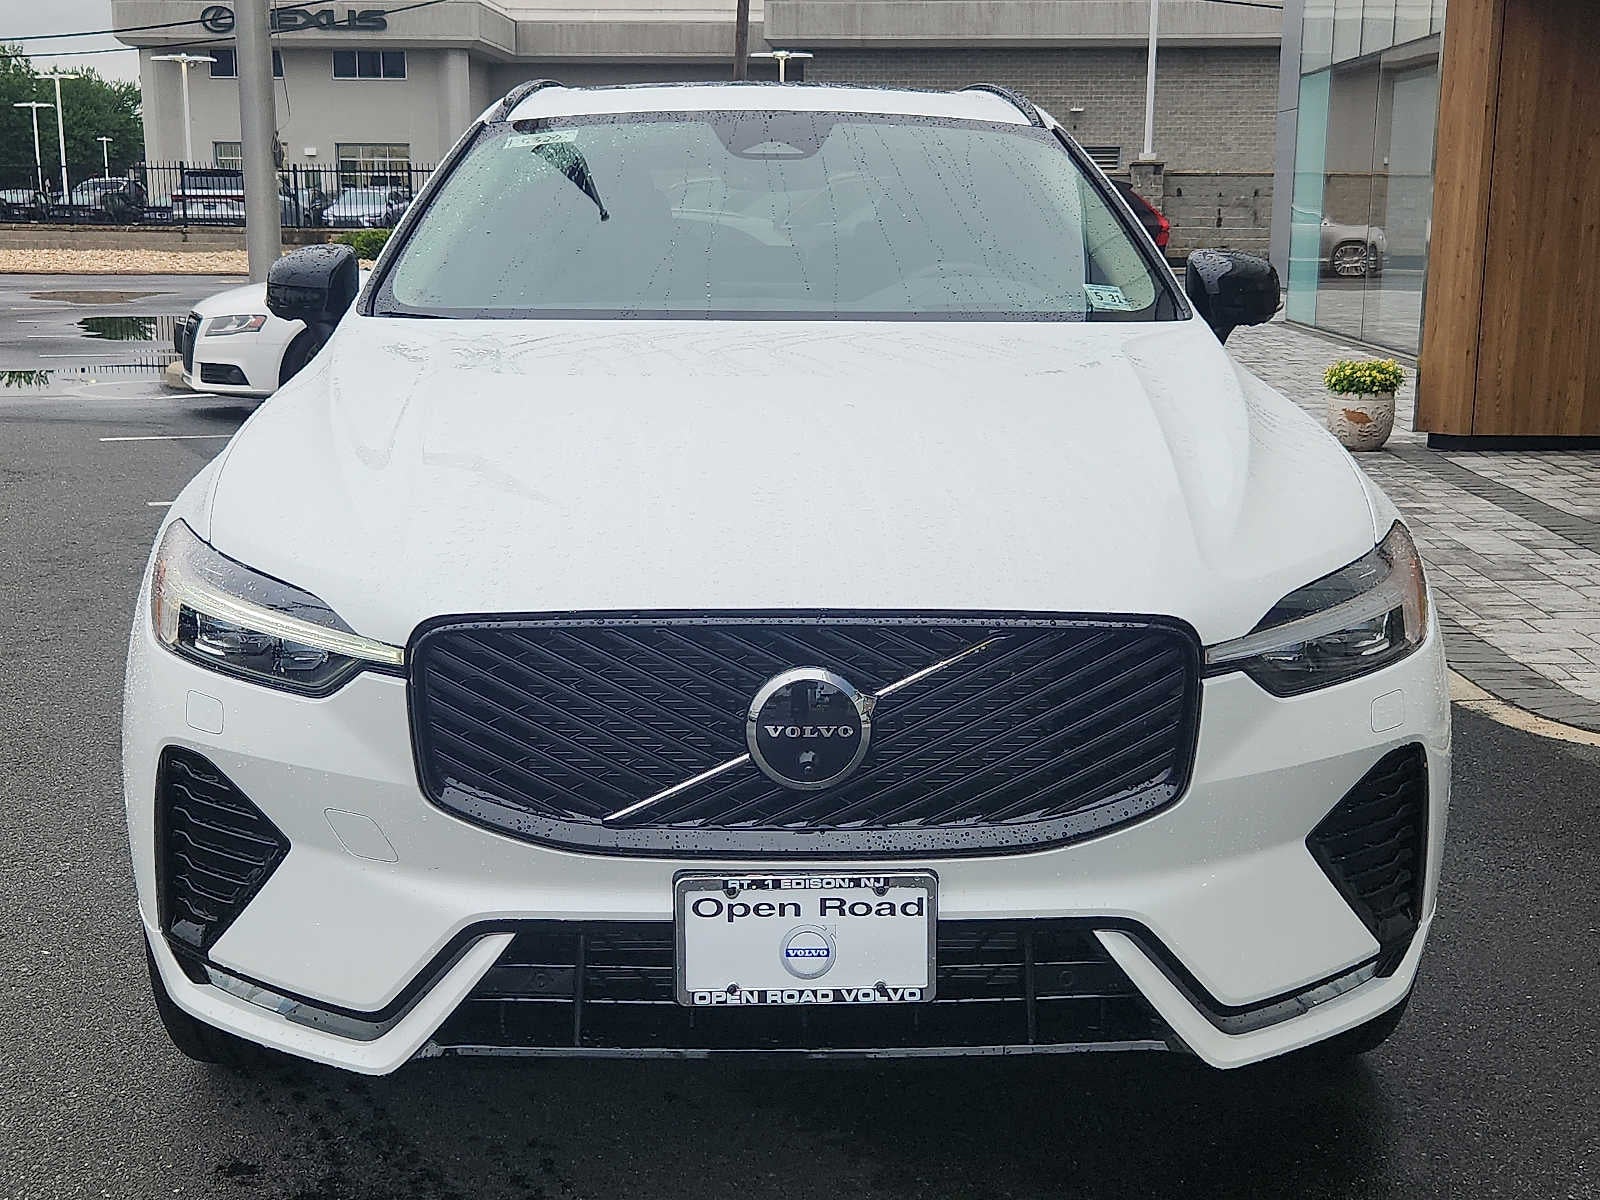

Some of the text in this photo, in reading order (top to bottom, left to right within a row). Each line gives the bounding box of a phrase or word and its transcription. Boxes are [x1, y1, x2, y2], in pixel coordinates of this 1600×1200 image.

[270, 9, 388, 31] EXUS
[763, 725, 854, 738] VOLVO
[764, 879, 773, 889] 1
[860, 877, 885, 888] NJ
[691, 897, 924, 922] Open Road
[788, 948, 830, 958] VOLVO
[693, 987, 921, 1005] OPEN ROAD VOLVO
